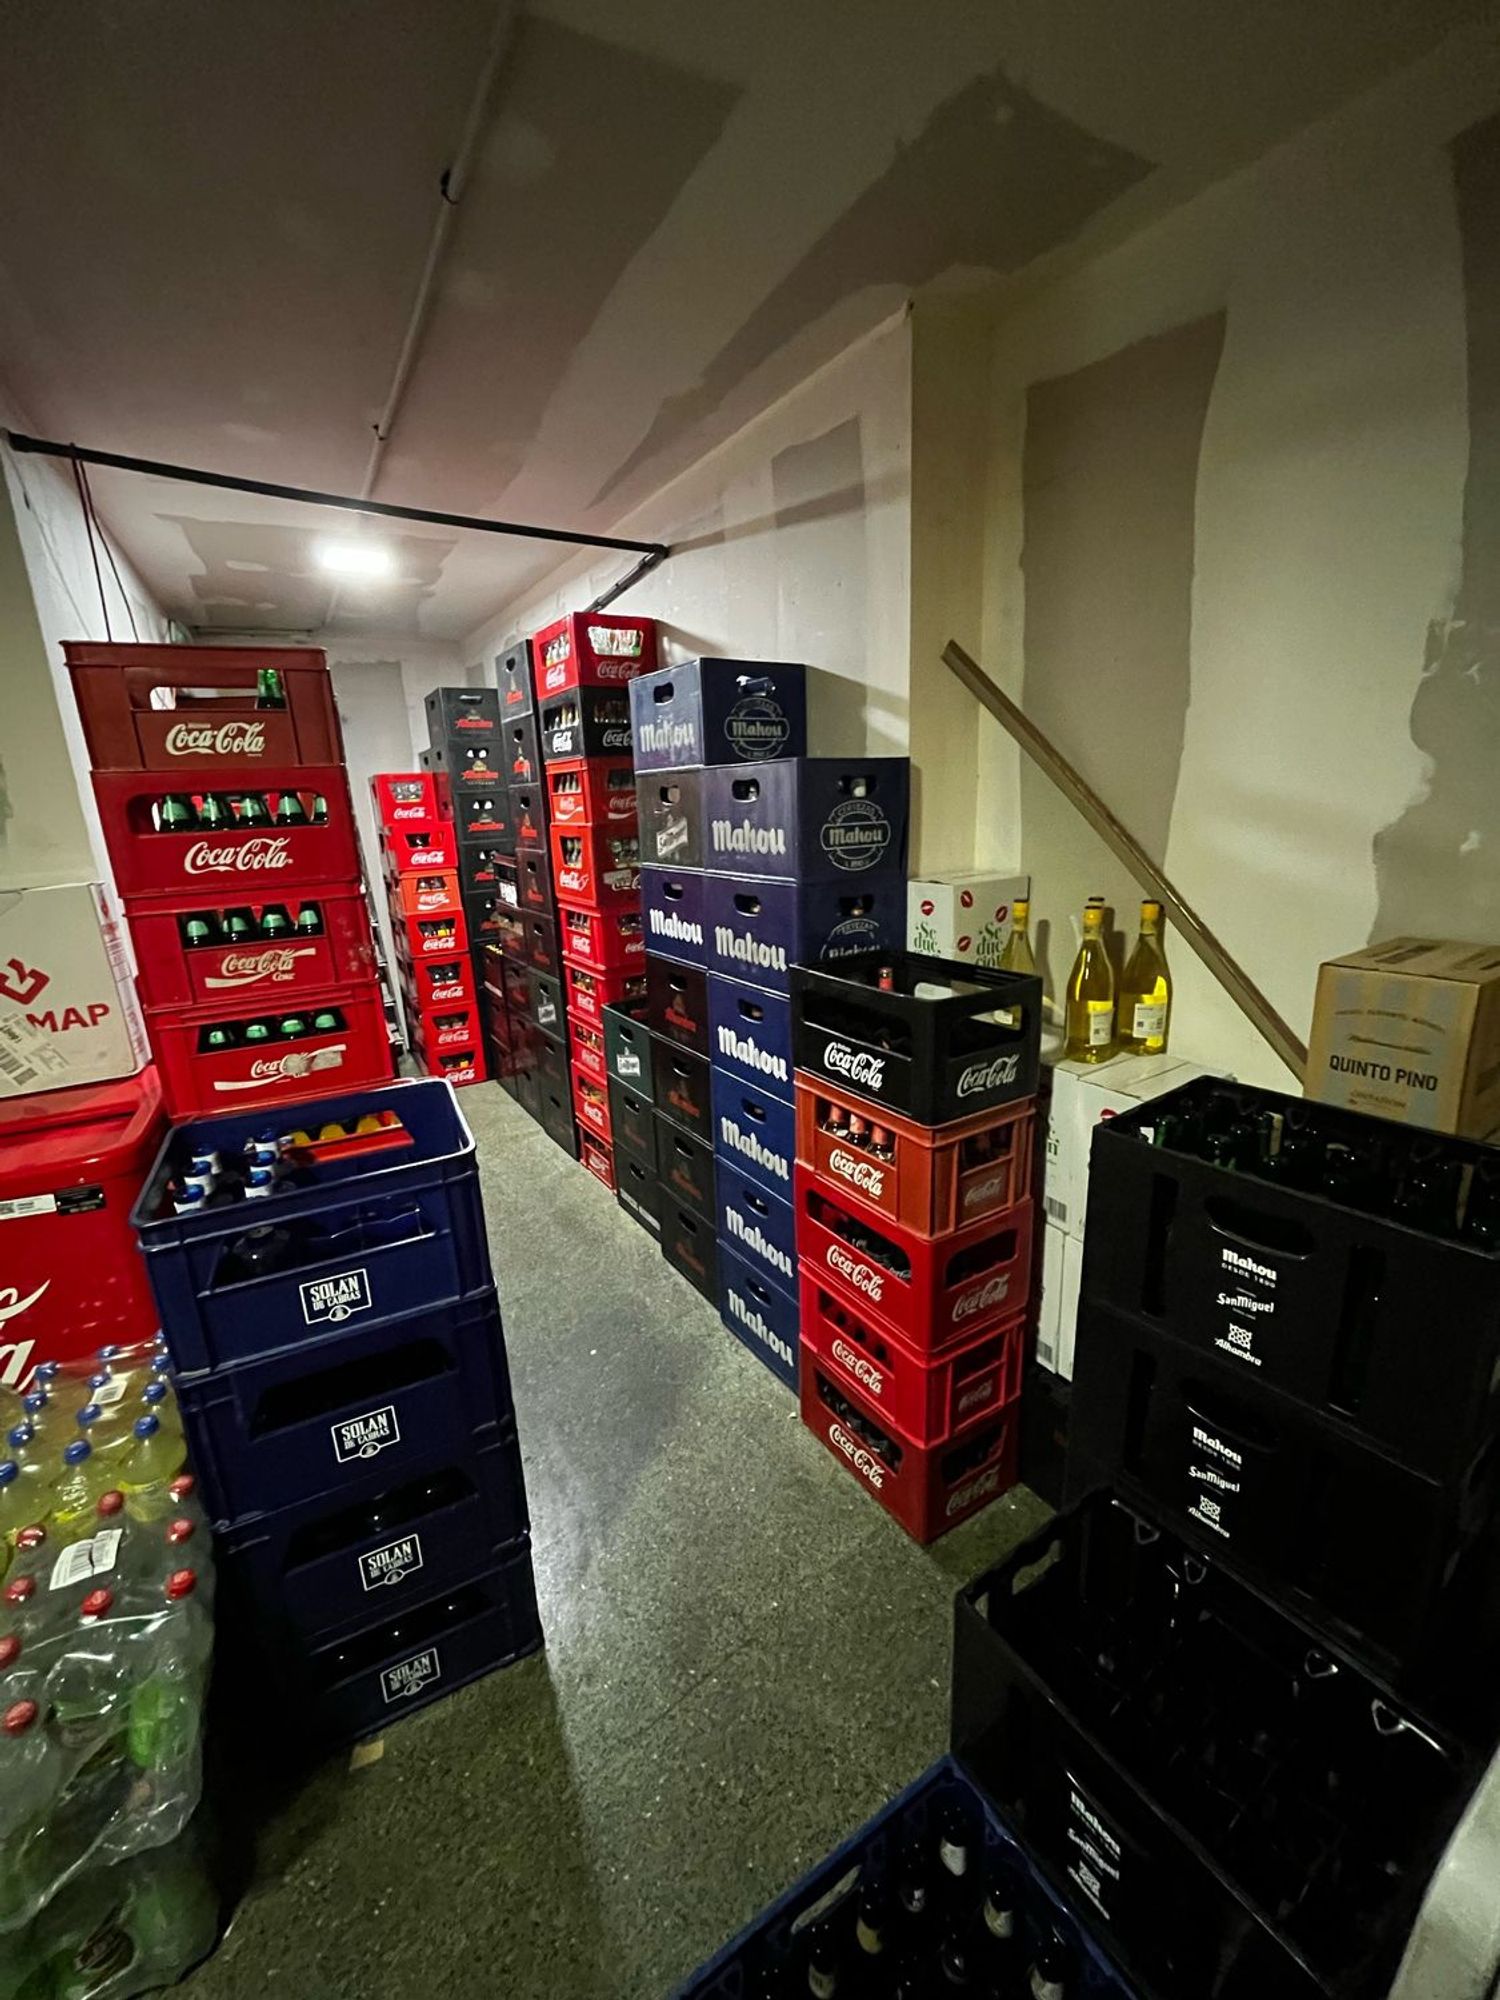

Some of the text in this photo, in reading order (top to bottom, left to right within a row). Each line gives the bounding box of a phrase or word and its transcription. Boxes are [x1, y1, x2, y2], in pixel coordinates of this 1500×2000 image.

[165, 722, 266, 756] Coca-Cola
[603, 729, 633, 747] Coca-C
[639, 721, 696, 752] Mahou
[732, 721, 782, 736] Mahou
[712, 819, 787, 854] Mahou
[829, 827, 882, 845] Mahou
[184, 837, 291, 874] Coca-Cola
[650, 908, 703, 945] Mahou
[221, 949, 296, 977] Coca-Cola
[715, 926, 787, 972] Mahou
[717, 1025, 788, 1082] Mahou
[824, 1041, 883, 1090] Coca-Cola
[957, 1054, 1020, 1098] Coca-Cola
[1329, 1055, 1438, 1092] QUINTO PINO
[721, 1117, 789, 1181] Mahou
[829, 1148, 883, 1196] Coca-Cola
[725, 1205, 794, 1278] Mahou
[827, 1244, 884, 1302] Coca-Cola
[1222, 1248, 1277, 1281] Mahou
[1216, 1292, 1274, 1314] SanMiguel
[728, 1288, 794, 1368] Mahou
[832, 1339, 882, 1395] Coca-Cola
[829, 1424, 886, 1489] Coca-Cola
[1193, 1426, 1242, 1464] Mahou
